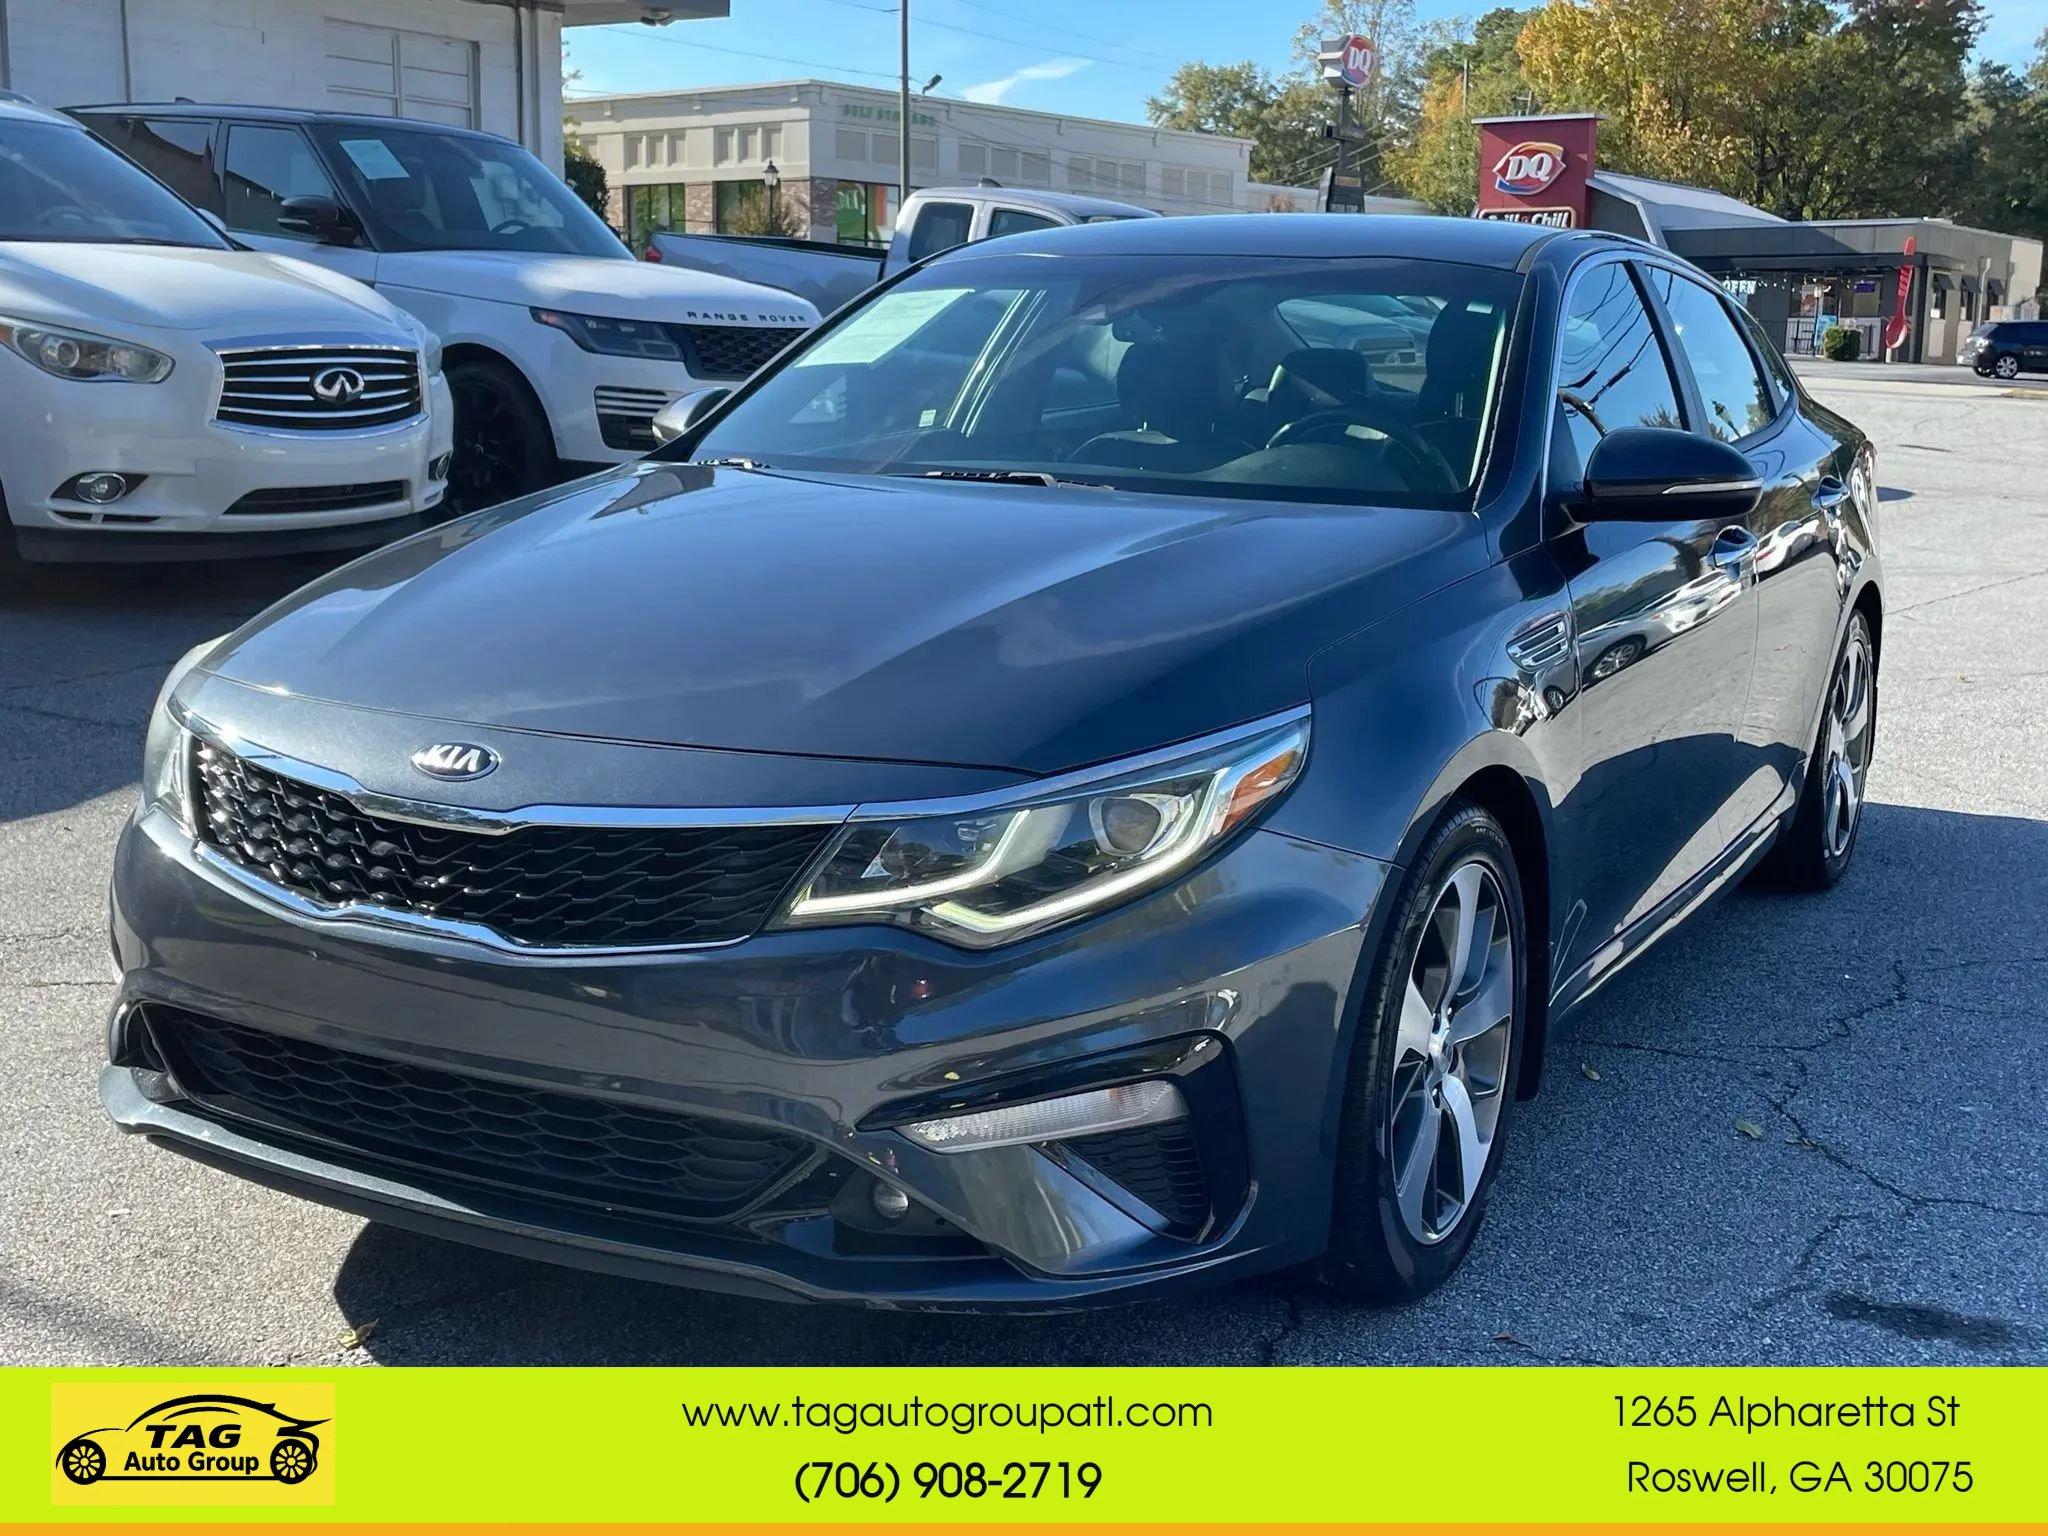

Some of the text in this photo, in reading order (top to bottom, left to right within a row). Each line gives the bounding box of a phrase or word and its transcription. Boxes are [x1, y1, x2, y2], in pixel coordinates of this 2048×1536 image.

[1347, 47, 1372, 75] DQ
[877, 108, 937, 126] STOAGE
[1505, 152, 1553, 182] DQ
[686, 311, 806, 323] RANGE ROVER
[421, 744, 481, 773] KIA
